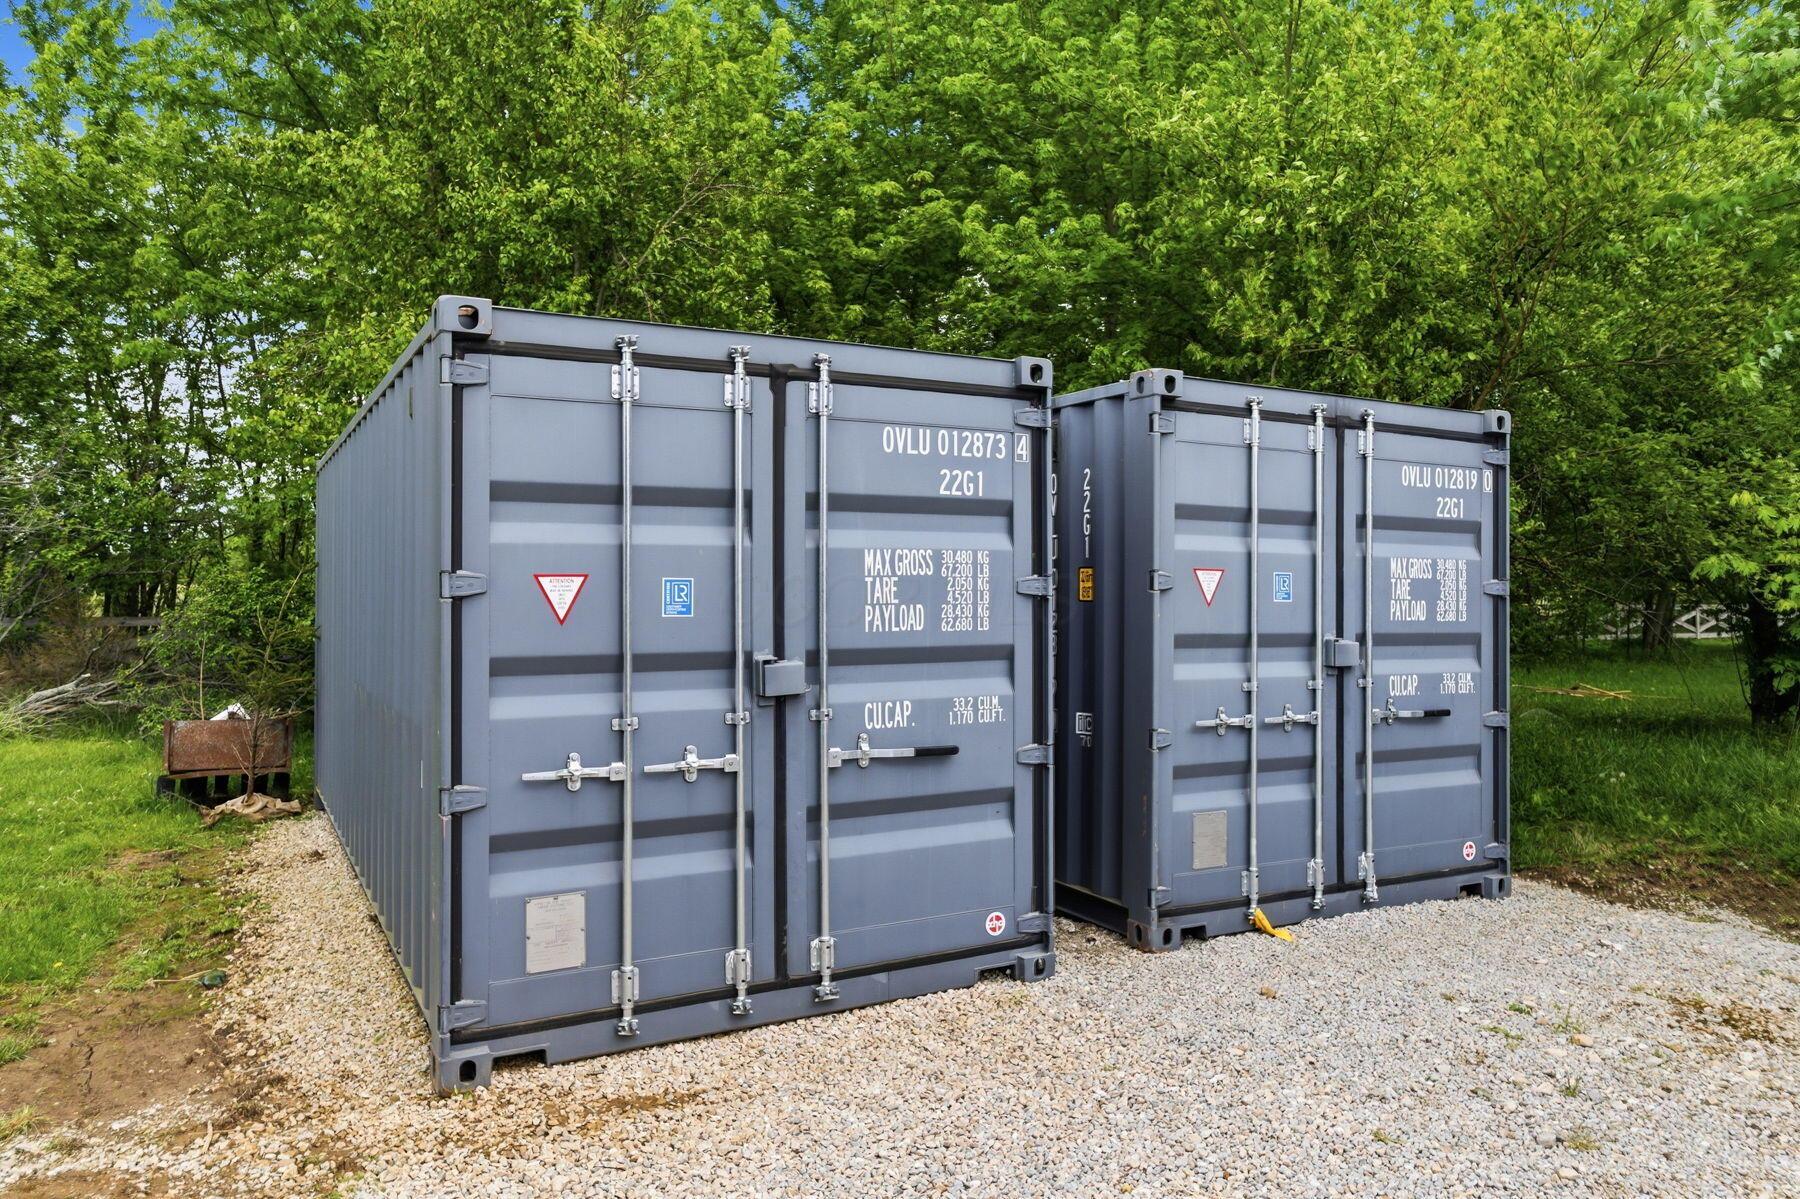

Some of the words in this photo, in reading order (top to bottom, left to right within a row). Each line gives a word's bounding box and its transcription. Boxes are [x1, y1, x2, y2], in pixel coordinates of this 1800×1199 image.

[882, 426, 931, 456] OVLU
[937, 429, 1006, 460] 012873
[1016, 434, 1028, 461] 4
[939, 468, 983, 497] 22G1
[1401, 464, 1431, 488] OVLU
[1435, 467, 1478, 490] 012819
[1483, 471, 1492, 493] 0
[1083, 468, 1091, 558] 22G1
[1436, 496, 1464, 519] 22G1
[864, 549, 892, 577] MAX
[894, 549, 934, 577] GROSS
[941, 550, 973, 564] 30.480
[977, 550, 990, 564] KG
[941, 563, 973, 578] 67.200
[977, 564, 990, 577] LB
[1390, 556, 1408, 579] MAX
[1408, 558, 1433, 579] GROSS
[1436, 559, 1457, 570] 30.480
[1458, 559, 1467, 570] KG
[1436, 569, 1457, 580] 67.200
[1458, 570, 1467, 580] LB
[675, 585, 688, 602] LR
[864, 576, 899, 605] TARE
[946, 577, 973, 591] 2.050
[977, 577, 990, 591] KG
[946, 590, 973, 605] 4.520
[977, 590, 990, 604] LB
[1390, 578, 1412, 600] TARE
[1458, 580, 1467, 591] KG
[1458, 590, 1467, 601] LB
[864, 603, 925, 633] PAYLOAD
[941, 603, 973, 619] 28.430
[977, 603, 990, 618] KG
[1390, 599, 1426, 622] PAYLOAD
[1436, 600, 1457, 611] 28.430
[1458, 600, 1467, 611] KG
[1436, 610, 1457, 622] 62.680
[1458, 611, 1467, 622] LB
[941, 617, 973, 632] 62.680
[977, 617, 990, 631] LB
[1389, 674, 1420, 697] CU.CAP.
[1442, 673, 1456, 684] 33.2
[864, 700, 916, 730] CU.CAP.
[953, 697, 974, 712] 33.2
[949, 710, 974, 726] 1.170
